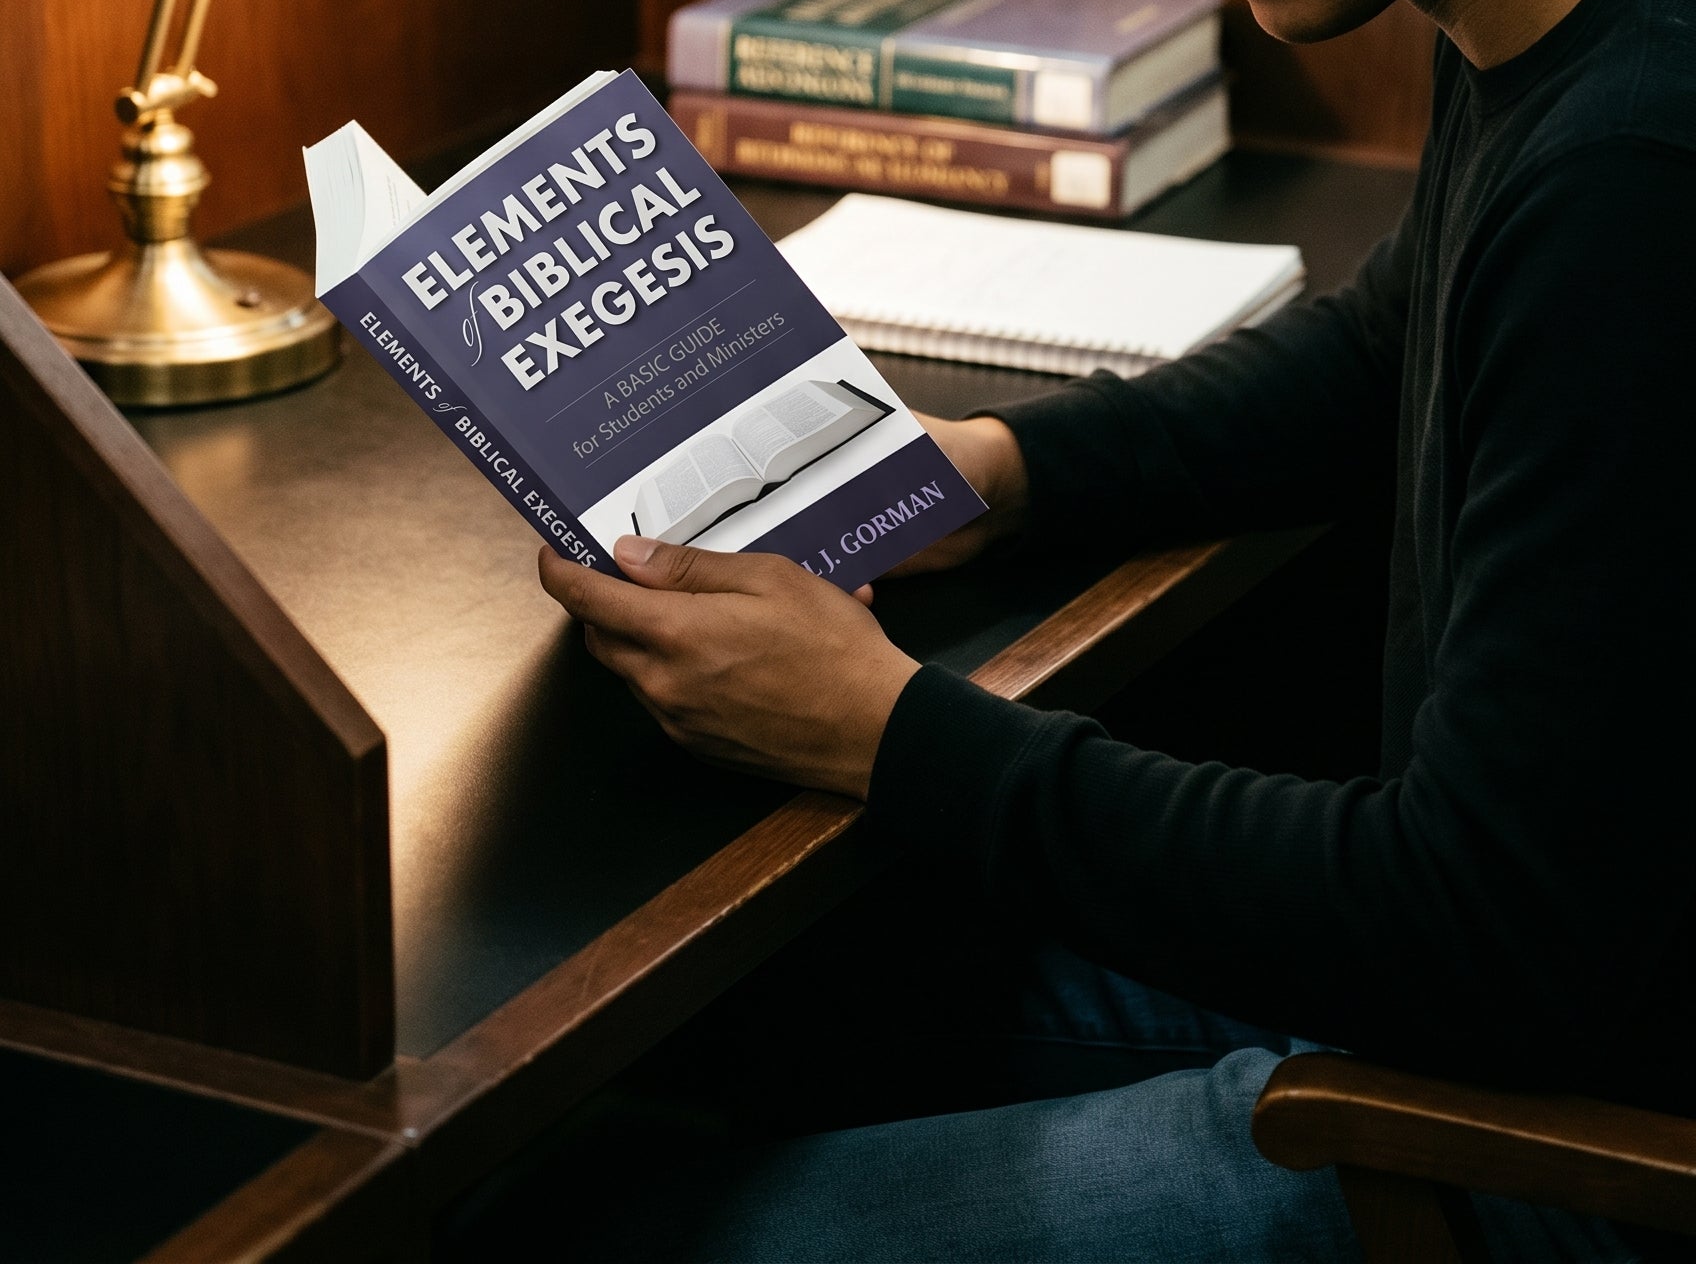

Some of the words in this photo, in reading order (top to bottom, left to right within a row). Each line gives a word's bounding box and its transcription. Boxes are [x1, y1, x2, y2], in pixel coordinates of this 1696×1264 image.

[402, 113, 656, 311] ELEMENTS
[462, 281, 482, 367] of
[477, 167, 701, 331] BIBLICAL
[501, 214, 735, 391] EXEGESIS
[572, 435, 600, 459] for
[598, 388, 675, 441] Students
[677, 358, 709, 390] and
[706, 312, 785, 369] Ministers
[603, 391, 619, 409] A
[616, 354, 670, 398] BASIC
[669, 317, 725, 363] GUIDE
[359, 311, 442, 400] ELEMENTS
[432, 402, 467, 413] of
[454, 416, 527, 494] BIBLICAL
[523, 490, 597, 569] EXEGESIS
[818, 548, 841, 574] J.
[840, 480, 945, 555] GORMAN
